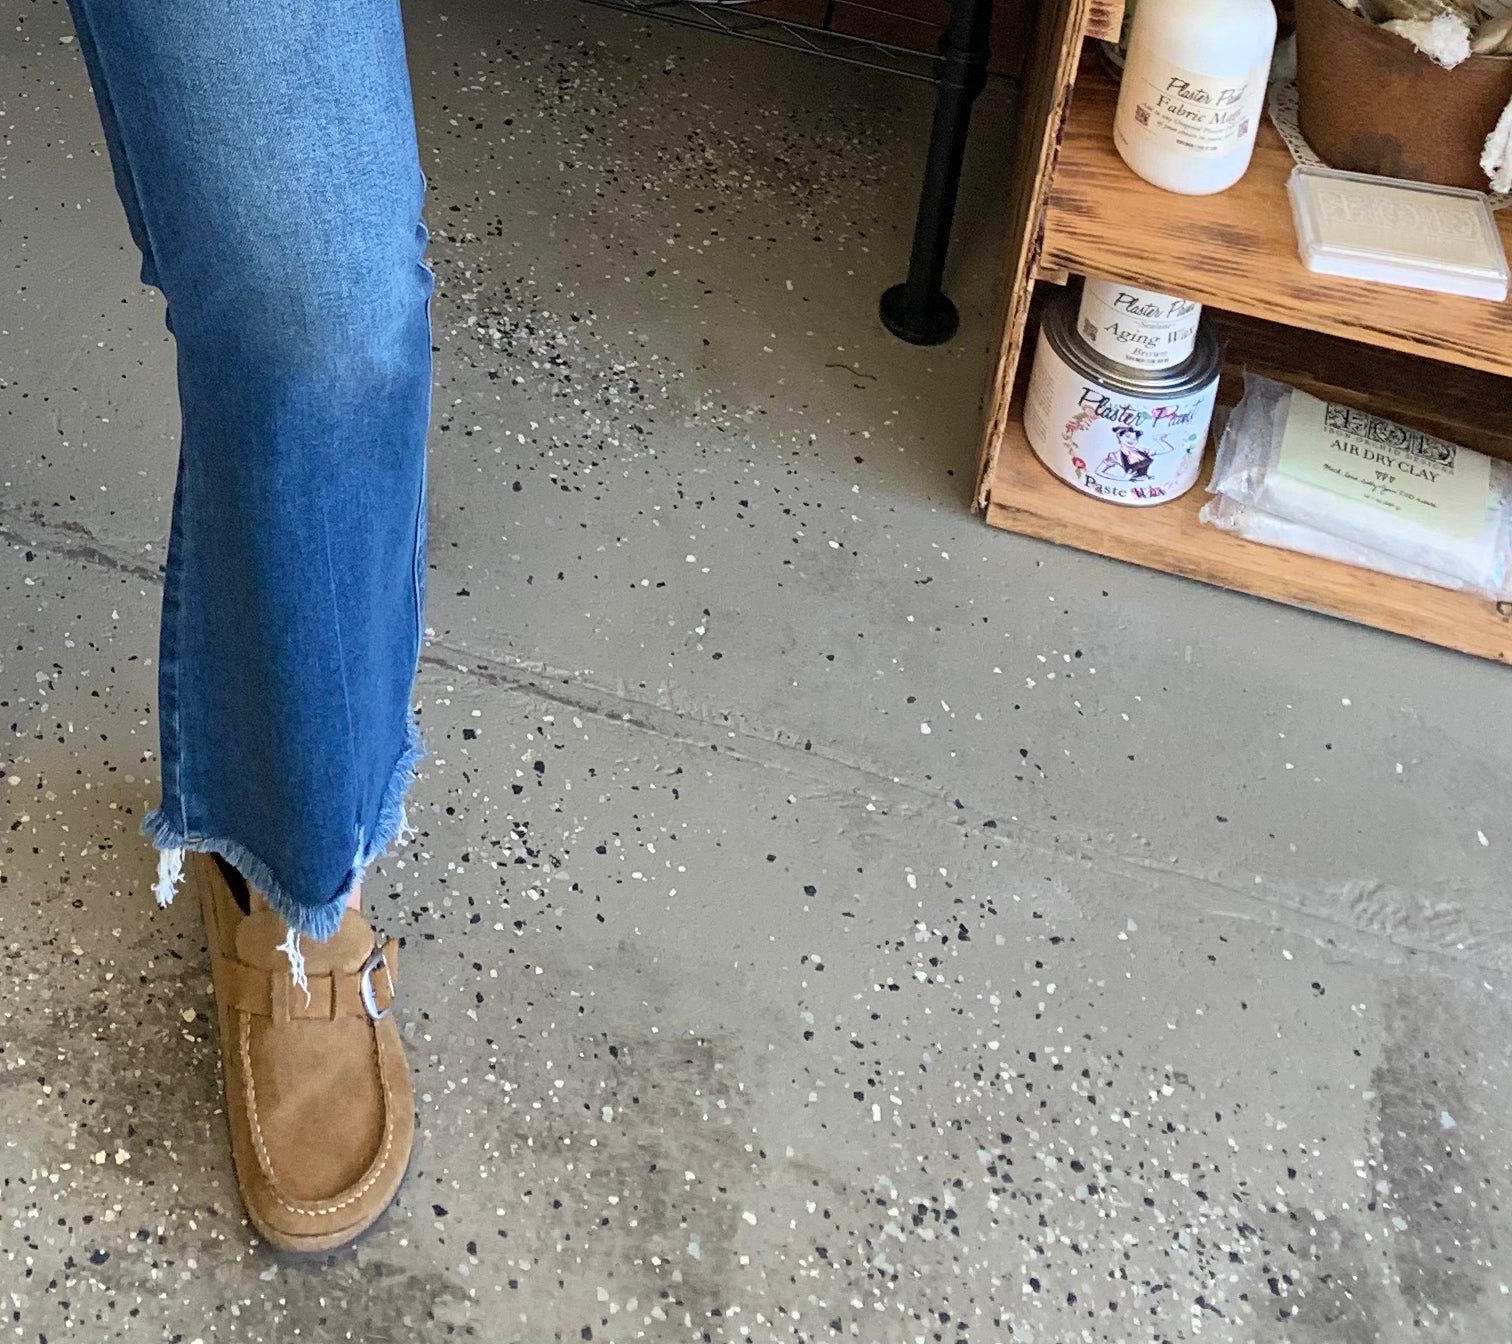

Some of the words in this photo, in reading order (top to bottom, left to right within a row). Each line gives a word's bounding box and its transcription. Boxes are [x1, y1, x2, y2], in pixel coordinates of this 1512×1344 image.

[1166, 77, 1213, 105] Plaster
[1156, 94, 1206, 123] Fabric
[1113, 292, 1164, 319] Plaster
[1104, 322, 1161, 349] Aging
[1132, 347, 1169, 357] Brown
[1078, 386, 1146, 427] Plaster
[1151, 397, 1206, 429] Paint
[1330, 438, 1361, 458] AIR
[1362, 450, 1396, 468] DRY
[1398, 460, 1440, 483] CLAY
[1083, 474, 1128, 498] Paste
